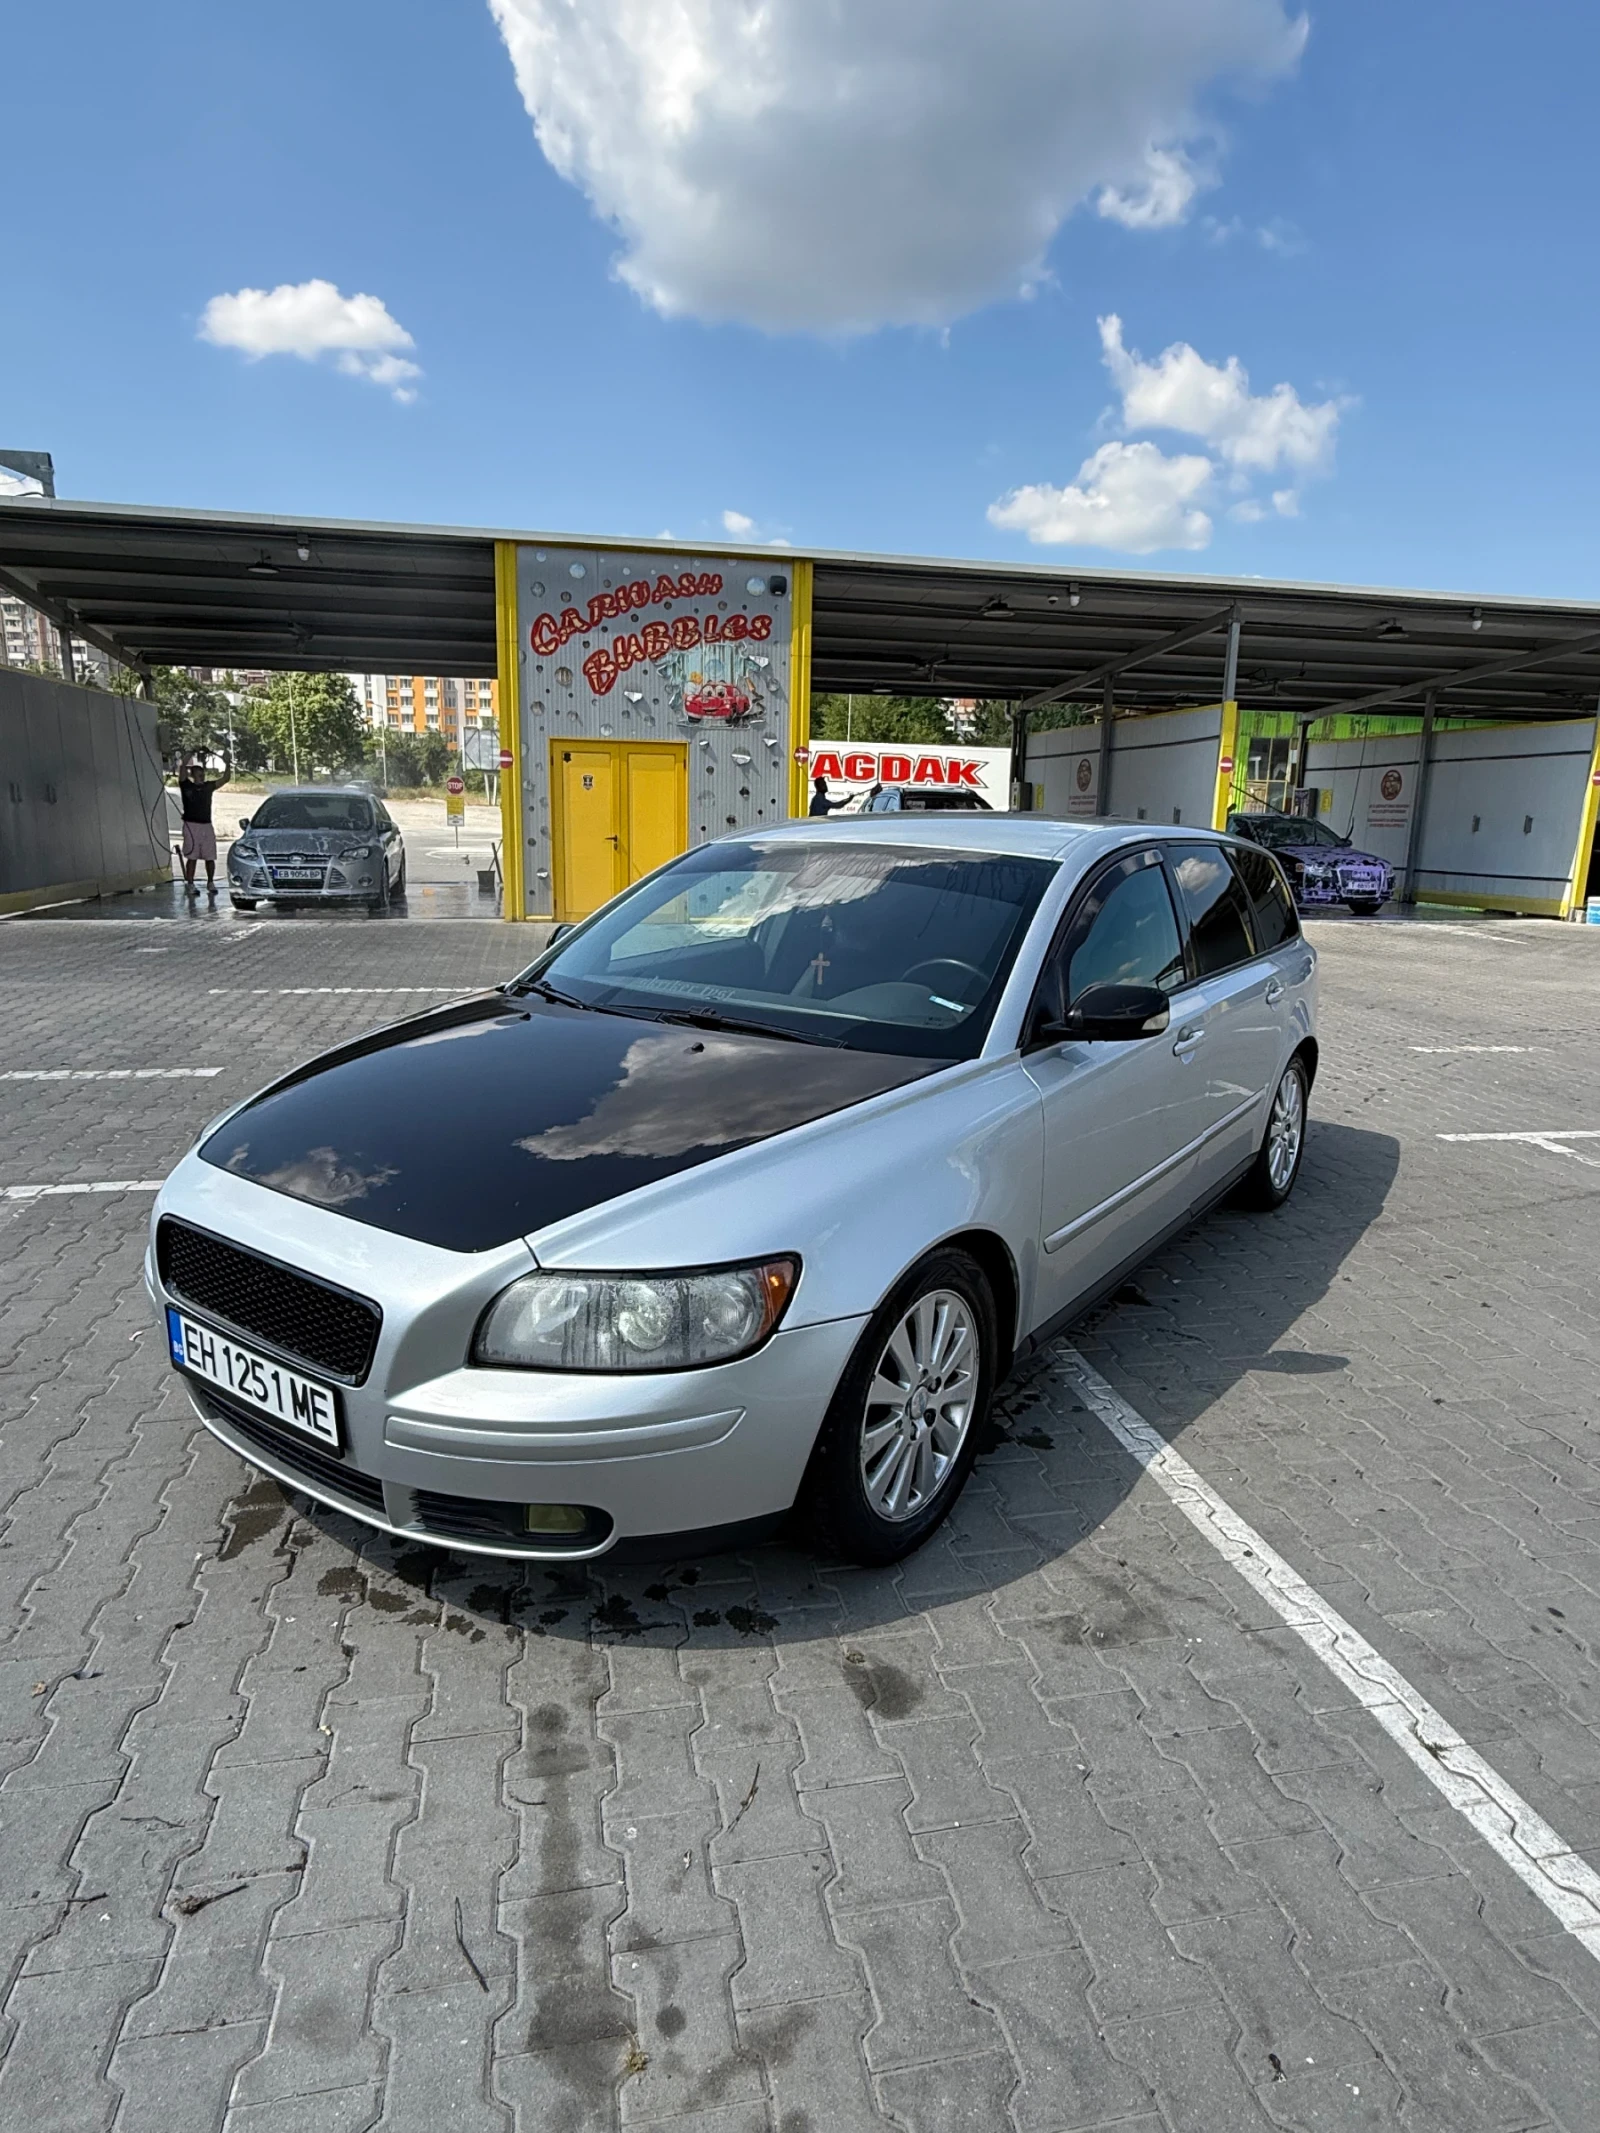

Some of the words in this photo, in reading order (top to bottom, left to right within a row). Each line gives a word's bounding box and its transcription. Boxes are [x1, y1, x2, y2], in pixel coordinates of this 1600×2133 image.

[531, 573, 722, 655] CARWASH
[583, 614, 772, 695] BUBBLES
[447, 782, 463, 790] STOP
[809, 751, 989, 788] AGDAK
[173, 1340, 184, 1355] BG
[183, 1323, 218, 1378] EH
[223, 1345, 285, 1413] 1251
[290, 1377, 333, 1438] ME
